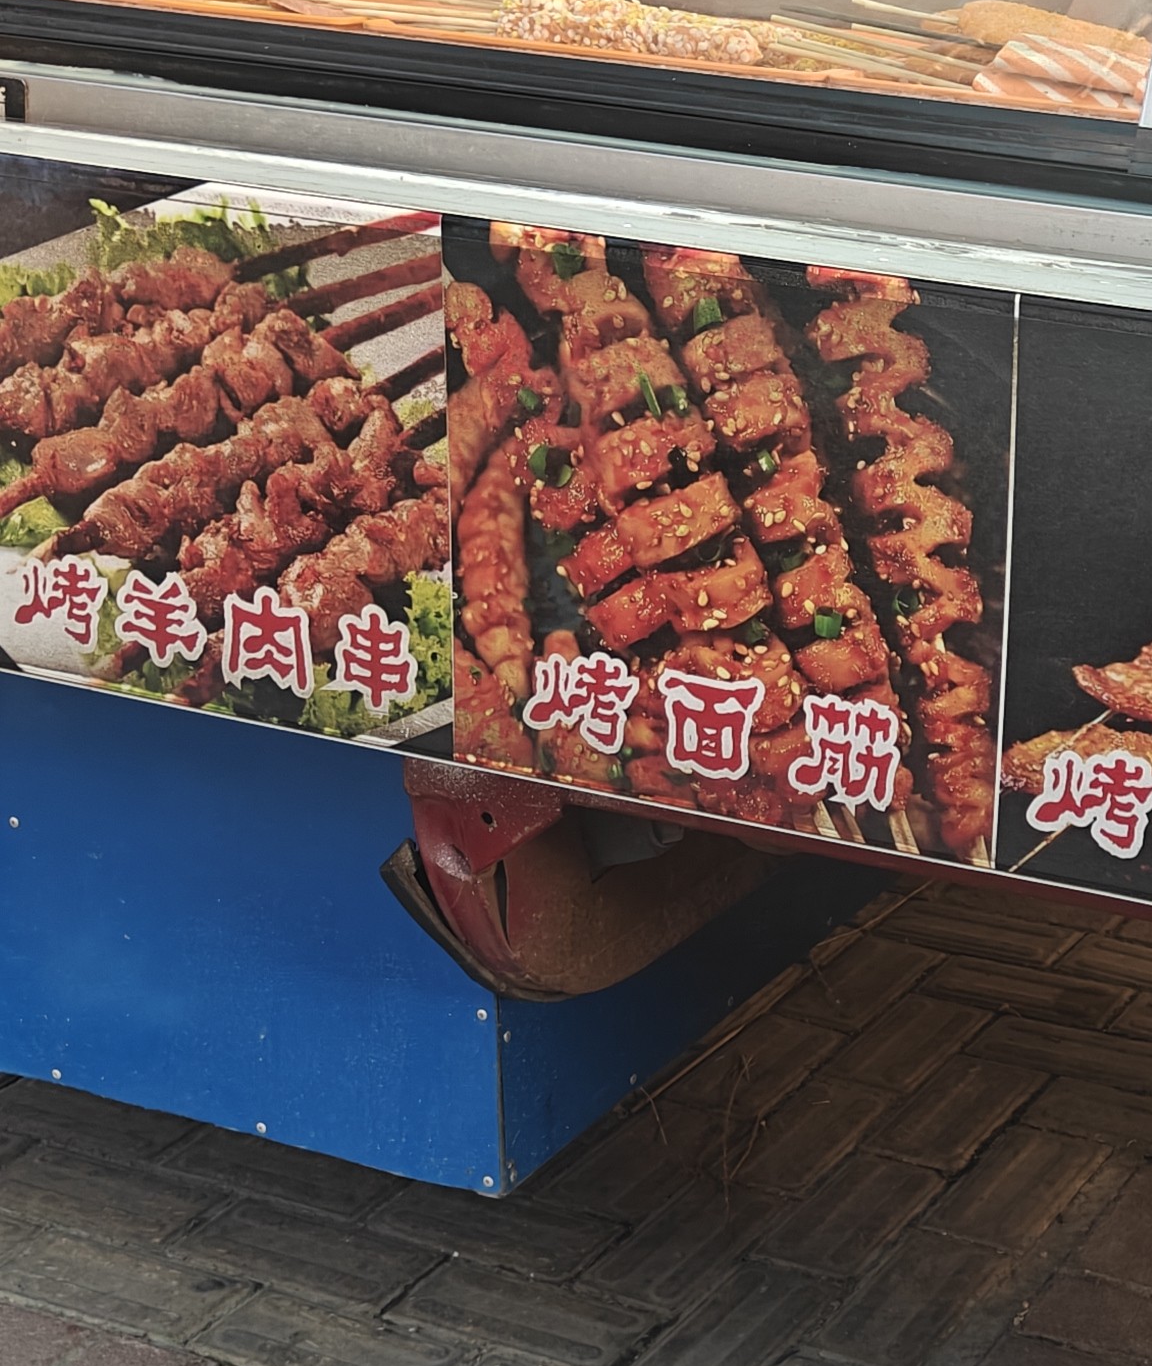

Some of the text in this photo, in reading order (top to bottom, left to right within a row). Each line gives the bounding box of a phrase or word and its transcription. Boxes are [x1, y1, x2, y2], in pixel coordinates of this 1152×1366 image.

[14, 556, 418, 711] 烤羊肉串
[523, 652, 912, 813] 烤面筋
